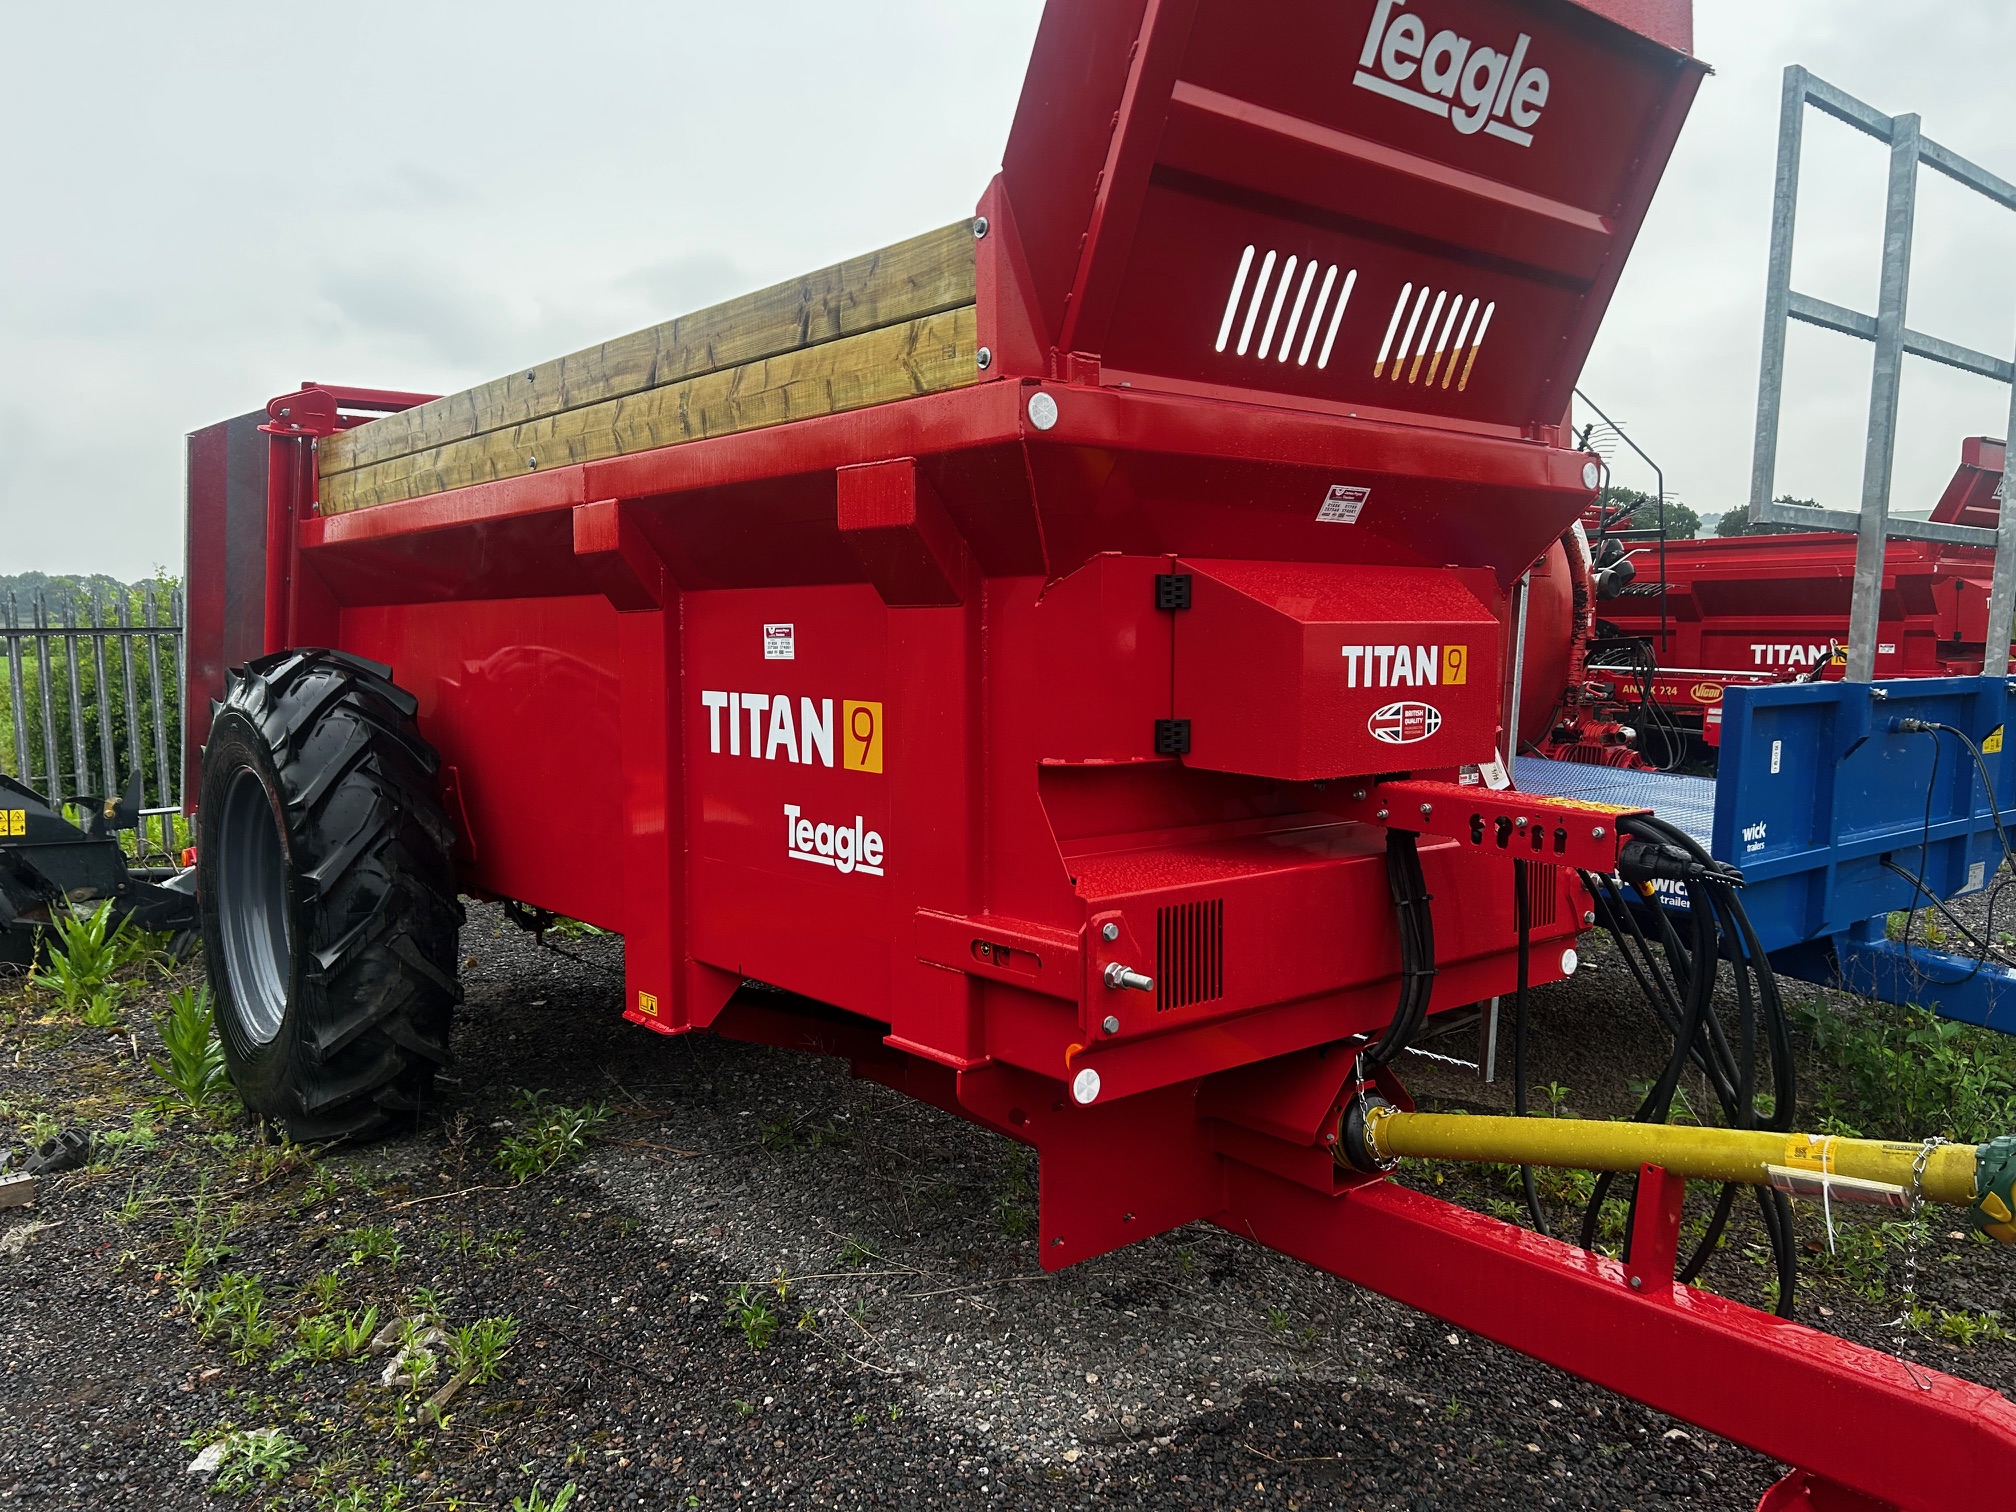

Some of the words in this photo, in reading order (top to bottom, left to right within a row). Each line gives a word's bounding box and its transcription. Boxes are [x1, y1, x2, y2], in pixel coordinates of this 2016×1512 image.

[1357, 0, 1550, 136] Teagle
[1750, 644, 1827, 666] TITAN
[1341, 645, 1438, 688] TITAN
[1448, 648, 1462, 682] 9
[1622, 684, 1657, 695] ANX
[1694, 683, 1721, 698] Vicon
[702, 690, 834, 768] TITAN
[851, 706, 874, 766] 9
[783, 803, 884, 874] Teagle
[1741, 820, 1767, 842] wick
[1746, 841, 1766, 852] trailers
[1651, 878, 1688, 896] wic
[1659, 894, 1691, 908] trailer
